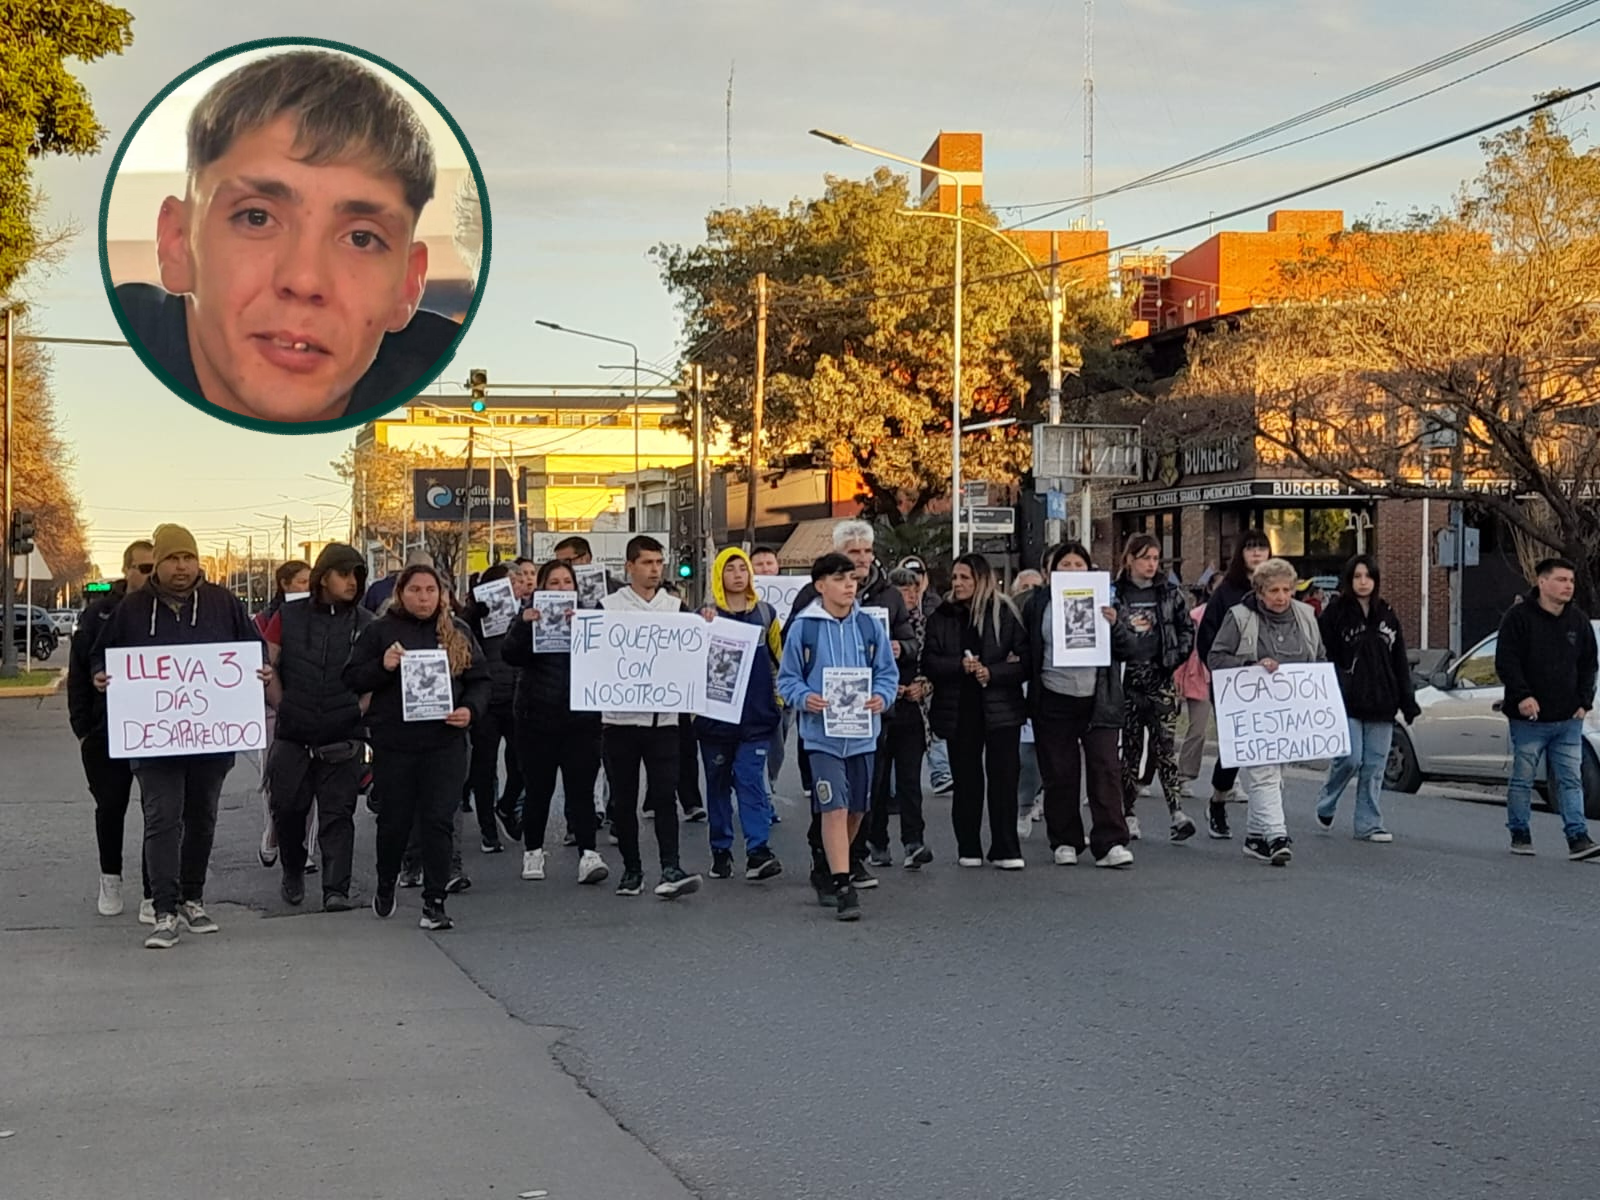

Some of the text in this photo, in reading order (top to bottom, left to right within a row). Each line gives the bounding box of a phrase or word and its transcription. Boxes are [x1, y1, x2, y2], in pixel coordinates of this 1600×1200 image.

[1203, 485, 1233, 500] AMERICAN
[1234, 483, 1252, 497] TASTE
[1272, 482, 1340, 495] BURGERS
[609, 623, 703, 656] QUEREMOS
[126, 652, 243, 688] LLEVA 3
[617, 655, 656, 680] CON
[156, 685, 209, 716] DÍAS
[1225, 706, 1336, 738] TE ESTAMOS
[1234, 731, 1347, 762] ESPERANDO!
